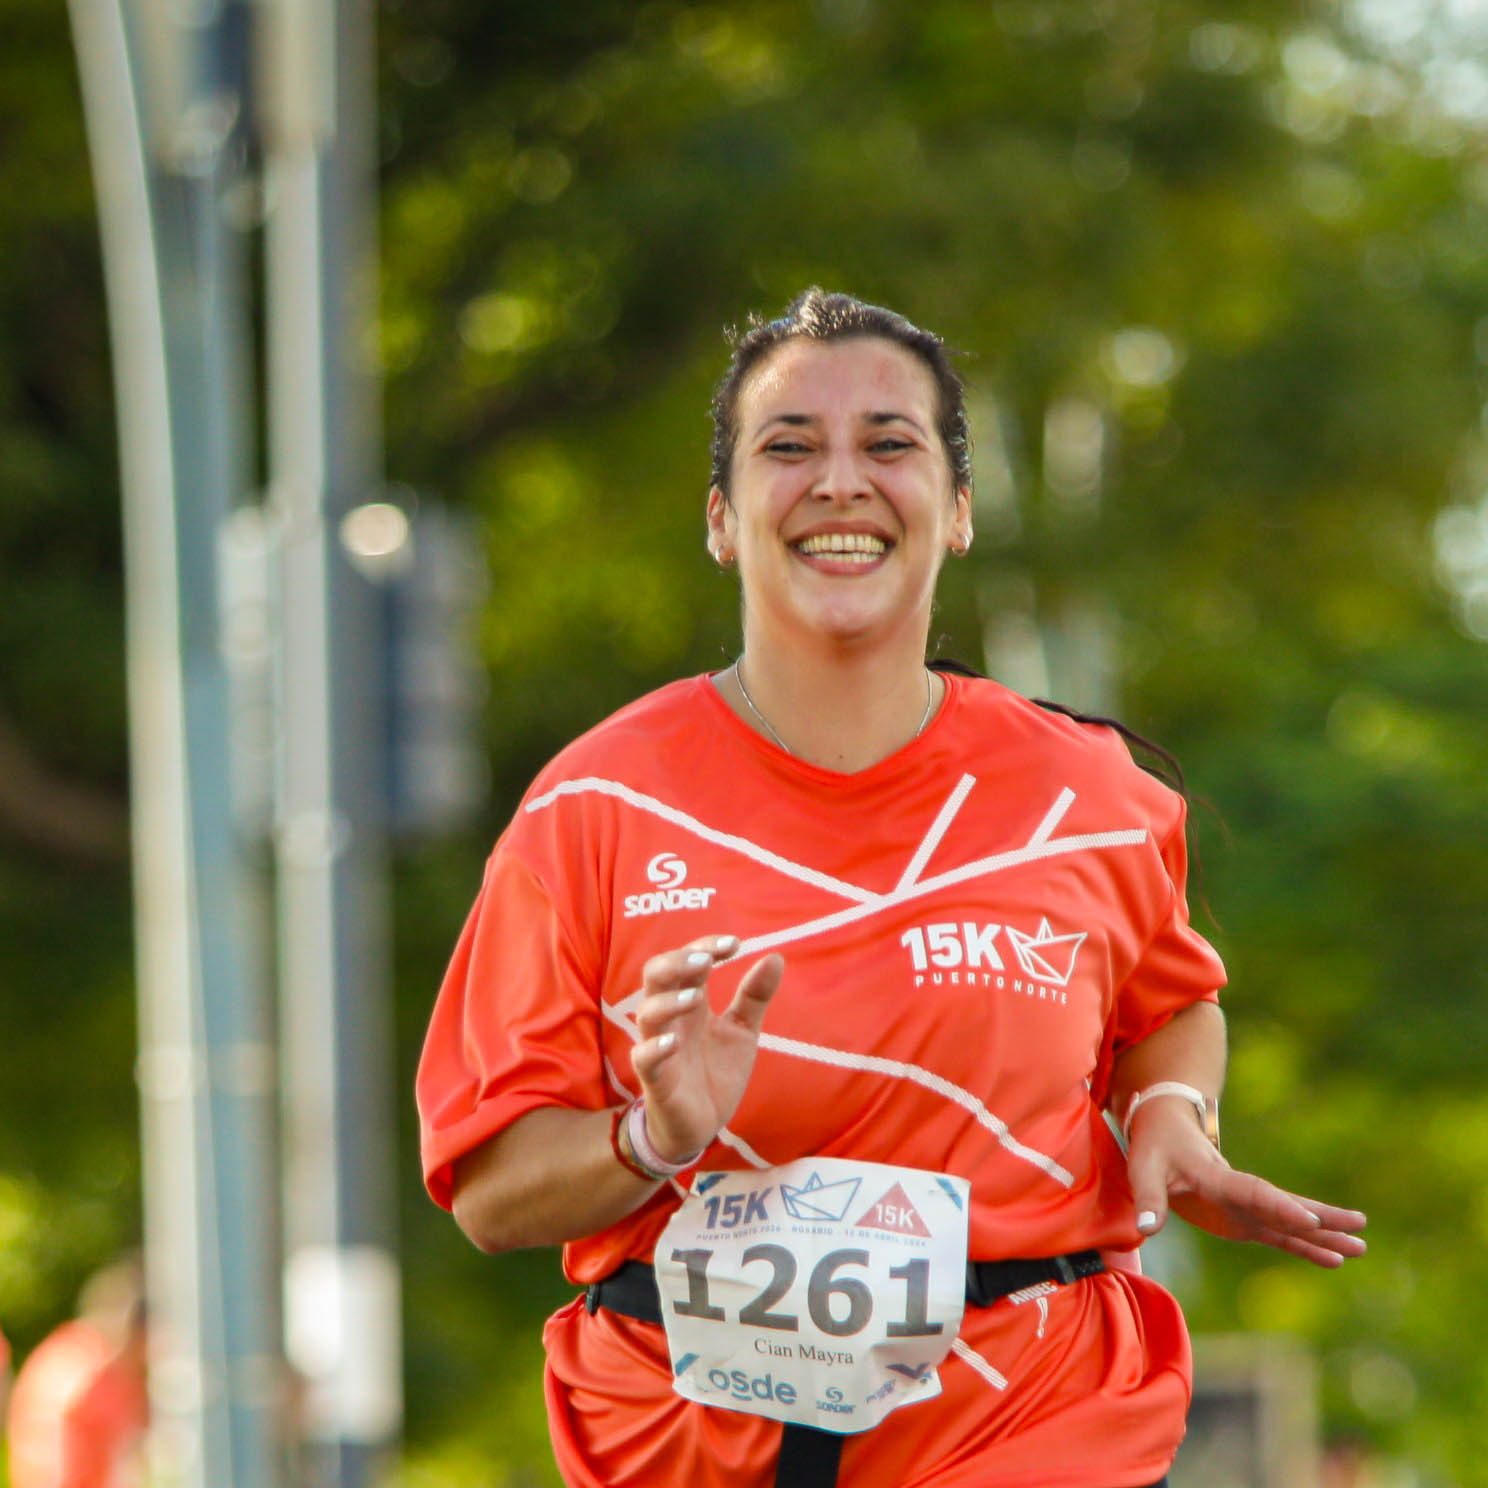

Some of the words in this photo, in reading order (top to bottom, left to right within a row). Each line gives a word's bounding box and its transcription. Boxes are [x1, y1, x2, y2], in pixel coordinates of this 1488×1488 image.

[901, 922, 1005, 971] 15K
[915, 972, 1005, 989] PUERTO
[1014, 980, 1068, 1004] NORTE
[704, 1186, 773, 1229] 15K
[875, 1202, 916, 1227] 15K
[671, 1243, 944, 1337] 1261
[754, 1338, 792, 1357] Cian
[799, 1343, 855, 1366] Mayra
[708, 1368, 798, 1404] osde
